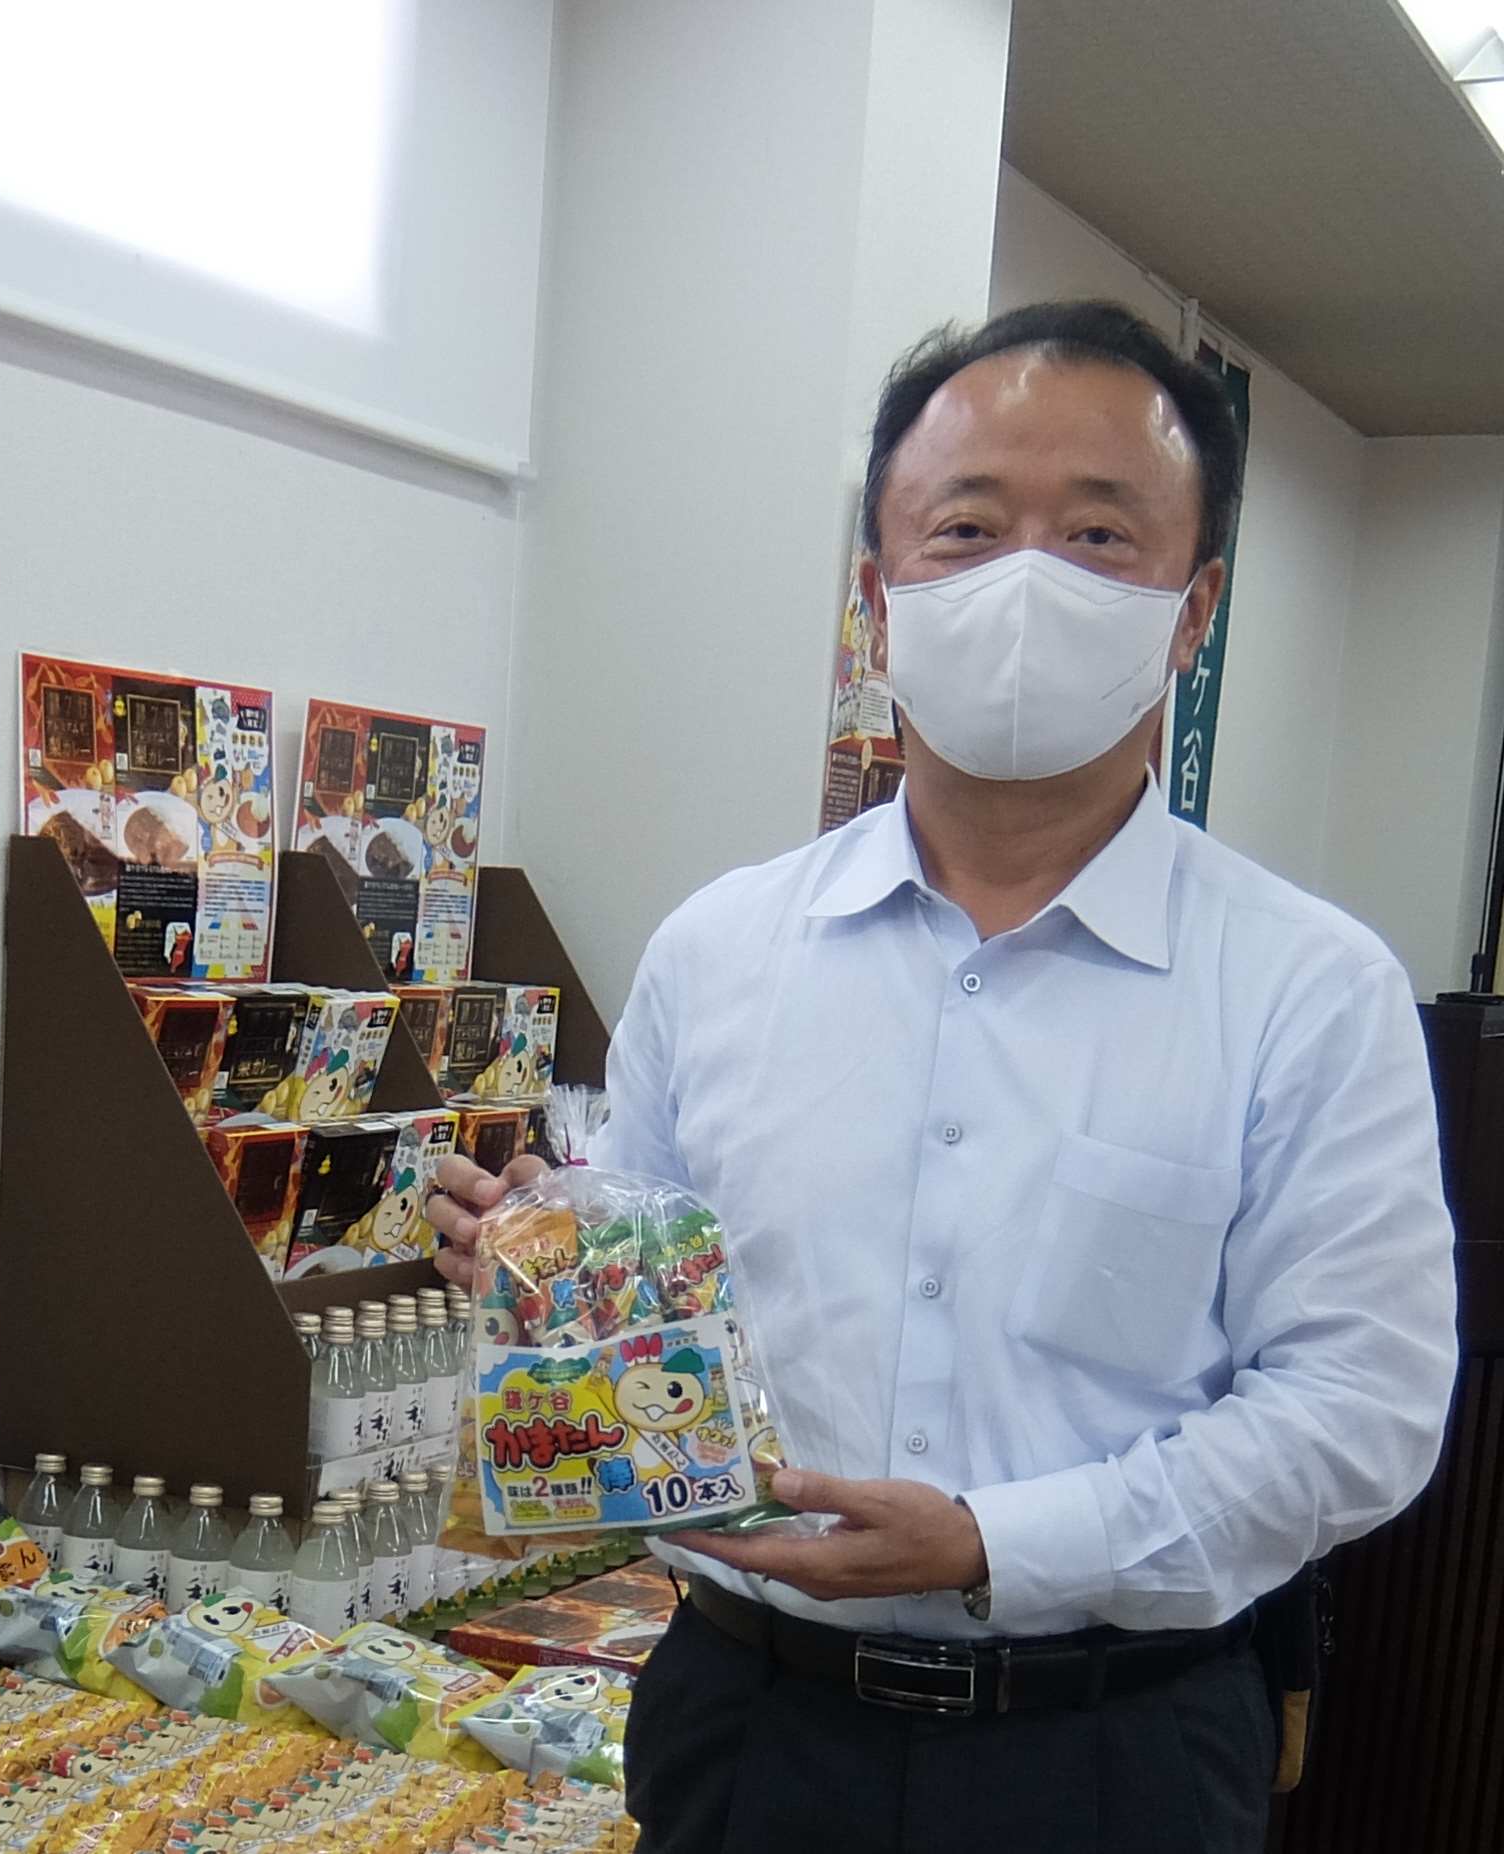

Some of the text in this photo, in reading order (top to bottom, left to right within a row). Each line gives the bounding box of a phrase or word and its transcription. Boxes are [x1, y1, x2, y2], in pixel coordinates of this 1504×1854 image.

[486, 1415, 624, 1467] かまたん
[645, 1474, 743, 1515] 10本入
